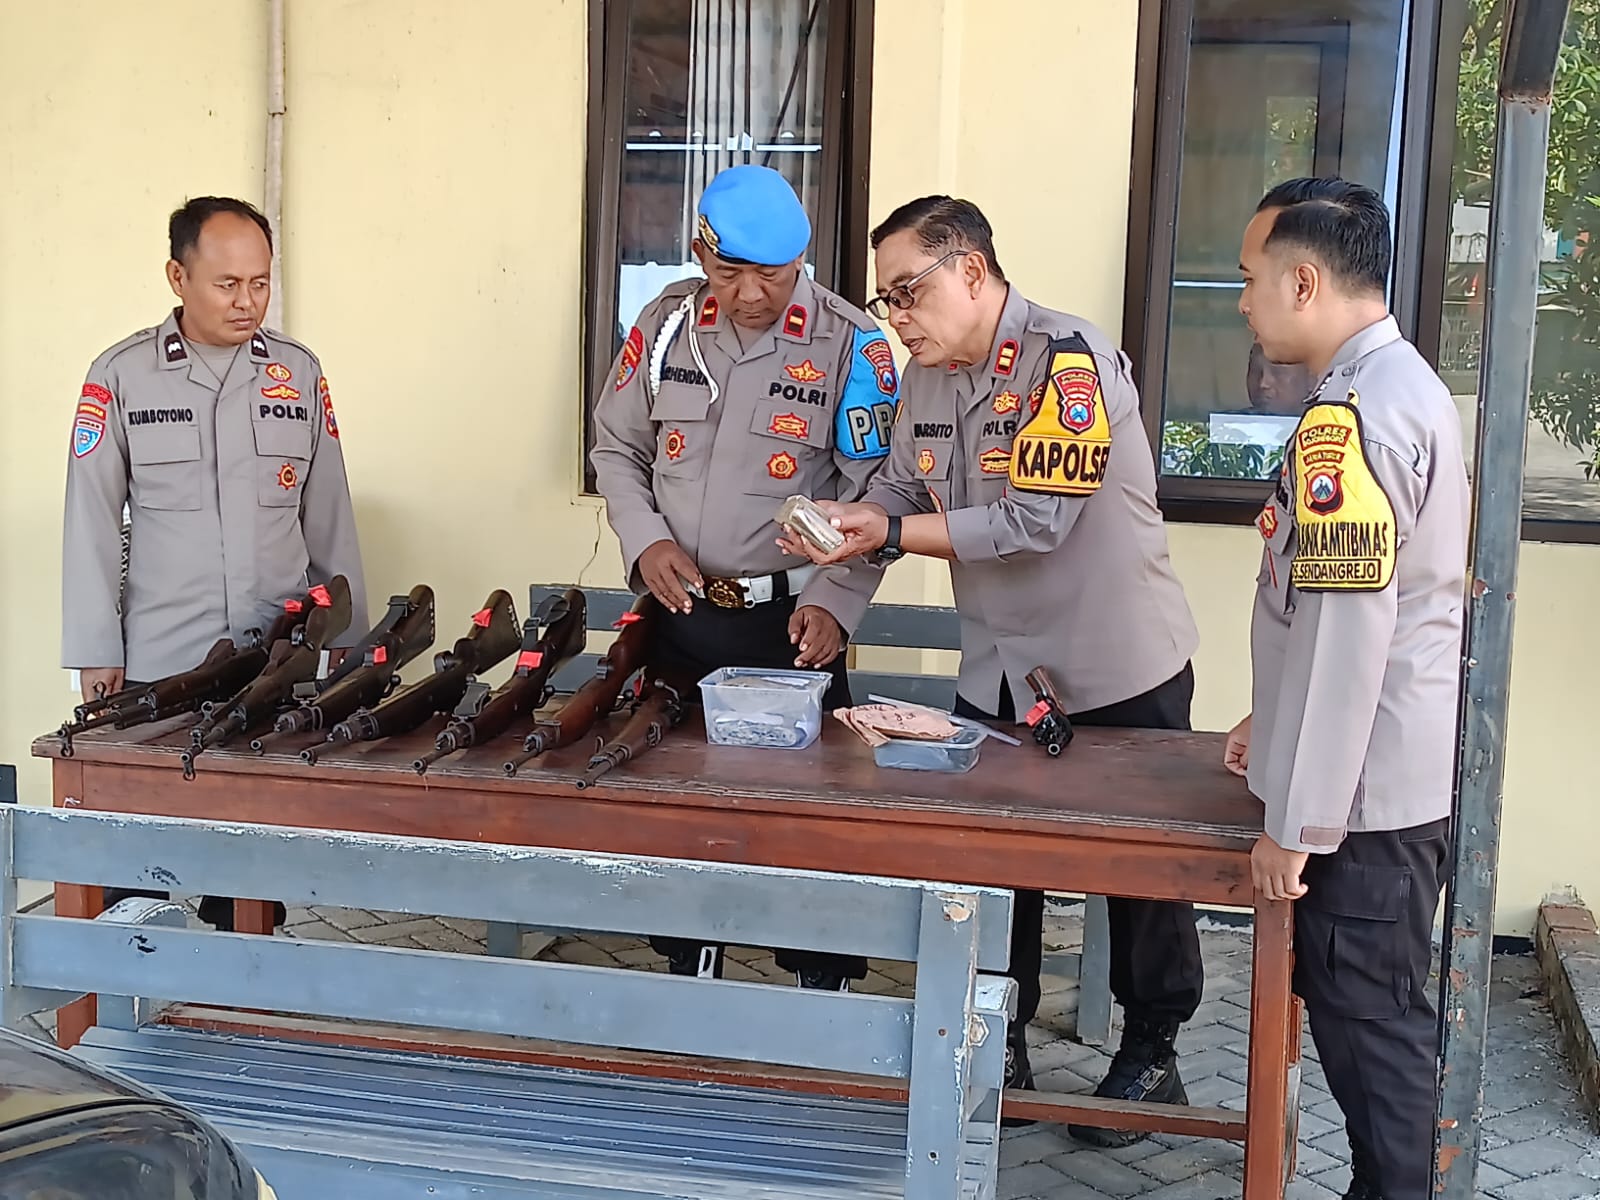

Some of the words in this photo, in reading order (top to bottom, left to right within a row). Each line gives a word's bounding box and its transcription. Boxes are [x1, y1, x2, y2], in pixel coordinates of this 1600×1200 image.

[769, 382, 827, 407] POLRI
[128, 408, 193, 426] KUMBOYONO
[259, 404, 308, 421] POLRI
[846, 402, 898, 454] PR
[982, 419, 1018, 437] POLR
[1302, 426, 1348, 441] POLRES
[1017, 439, 1110, 483] KAPOLSE
